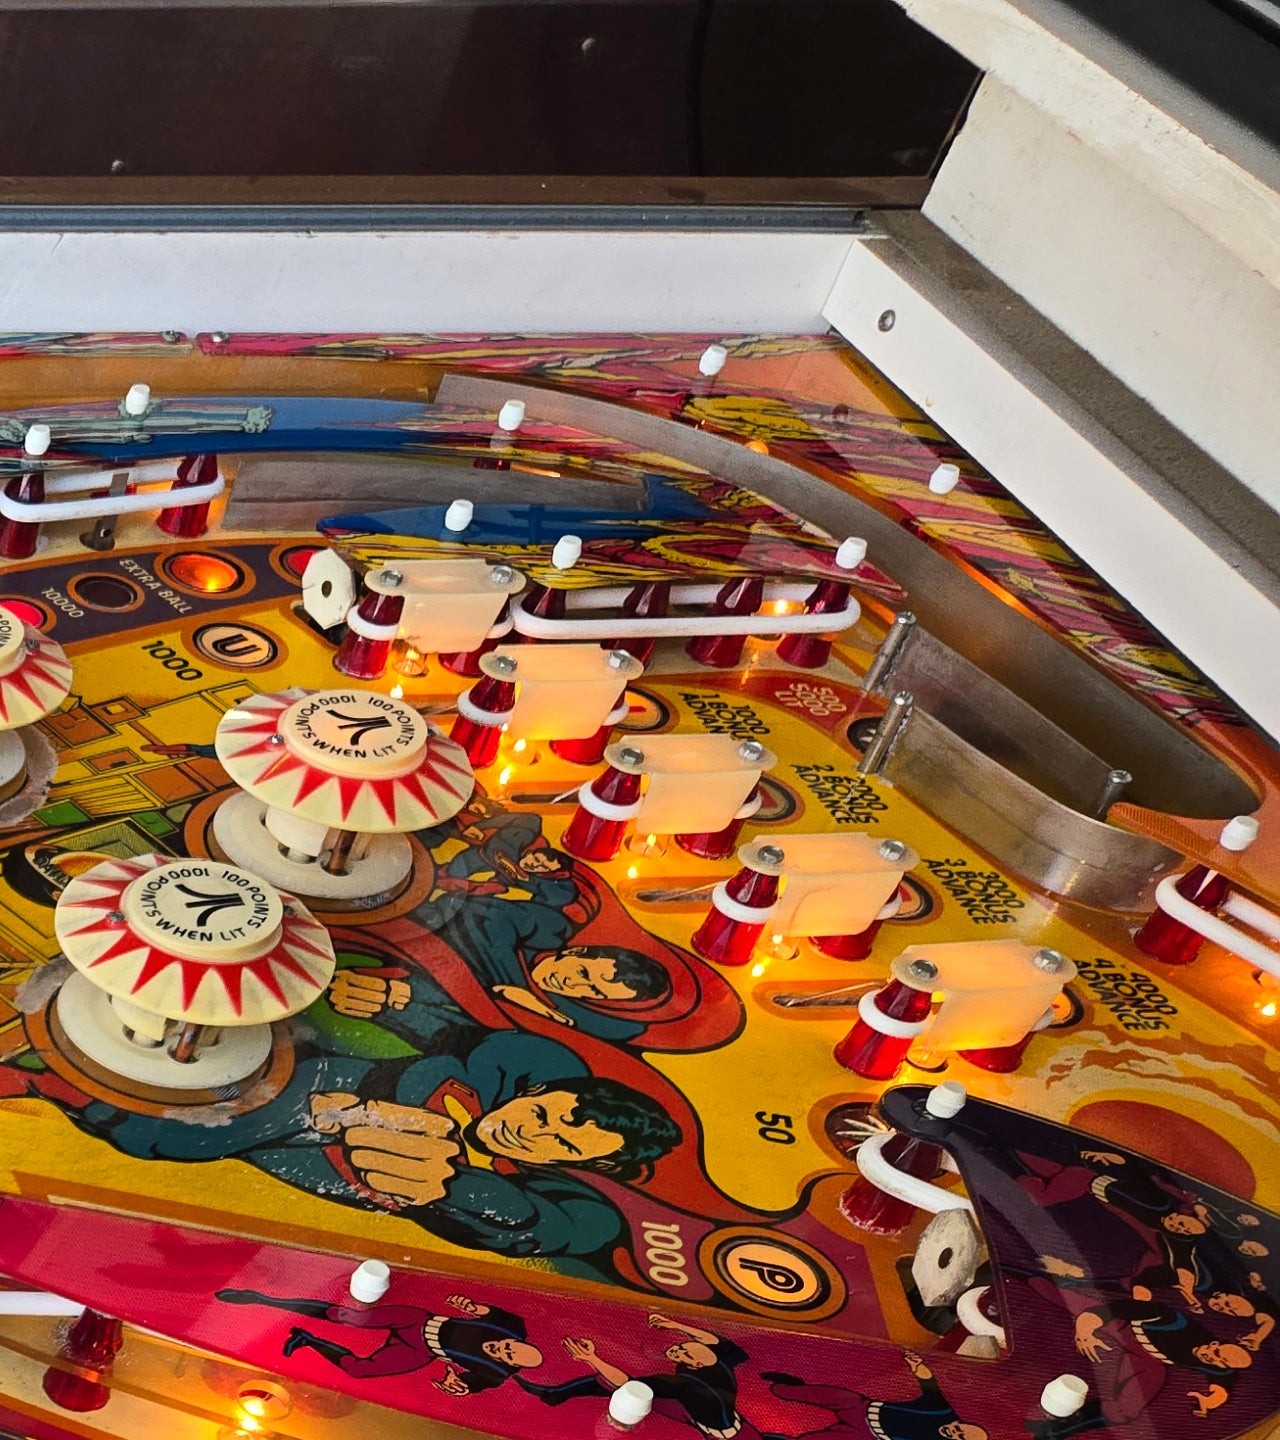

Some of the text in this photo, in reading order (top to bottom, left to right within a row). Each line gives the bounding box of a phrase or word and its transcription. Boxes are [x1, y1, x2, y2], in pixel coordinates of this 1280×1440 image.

[40, 587, 85, 618] 10000
[119, 558, 192, 614] EXTRA BALL
[141, 640, 203, 681] 1000
[212, 633, 263, 657] U
[678, 692, 732, 734] ADVAN
[732, 704, 771, 735] 1000
[774, 690, 803, 708] LIT
[790, 683, 831, 716] 5000
[813, 683, 847, 713] 500
[295, 695, 397, 758] 1000 POINTS WHEN LIT
[368, 697, 415, 746] 100 POINTS
[708, 702, 756, 741] BONU
[789, 764, 858, 824] ADVANCE
[822, 776, 880, 824] BONUS
[141, 867, 246, 942] 1000 POINTS WHEN LIT
[221, 870, 270, 929] 100 POINTS
[921, 858, 996, 925] ADVANCE
[955, 870, 1017, 924] BONUS
[978, 871, 1026, 909] 3000
[1072, 958, 1147, 1032] ADVANCE
[1102, 972, 1171, 1032] BONUS
[1131, 971, 1178, 1017] 4000
[755, 1110, 796, 1145] 50
[641, 1220, 689, 1287] 1000
[739, 1257, 805, 1294] P
